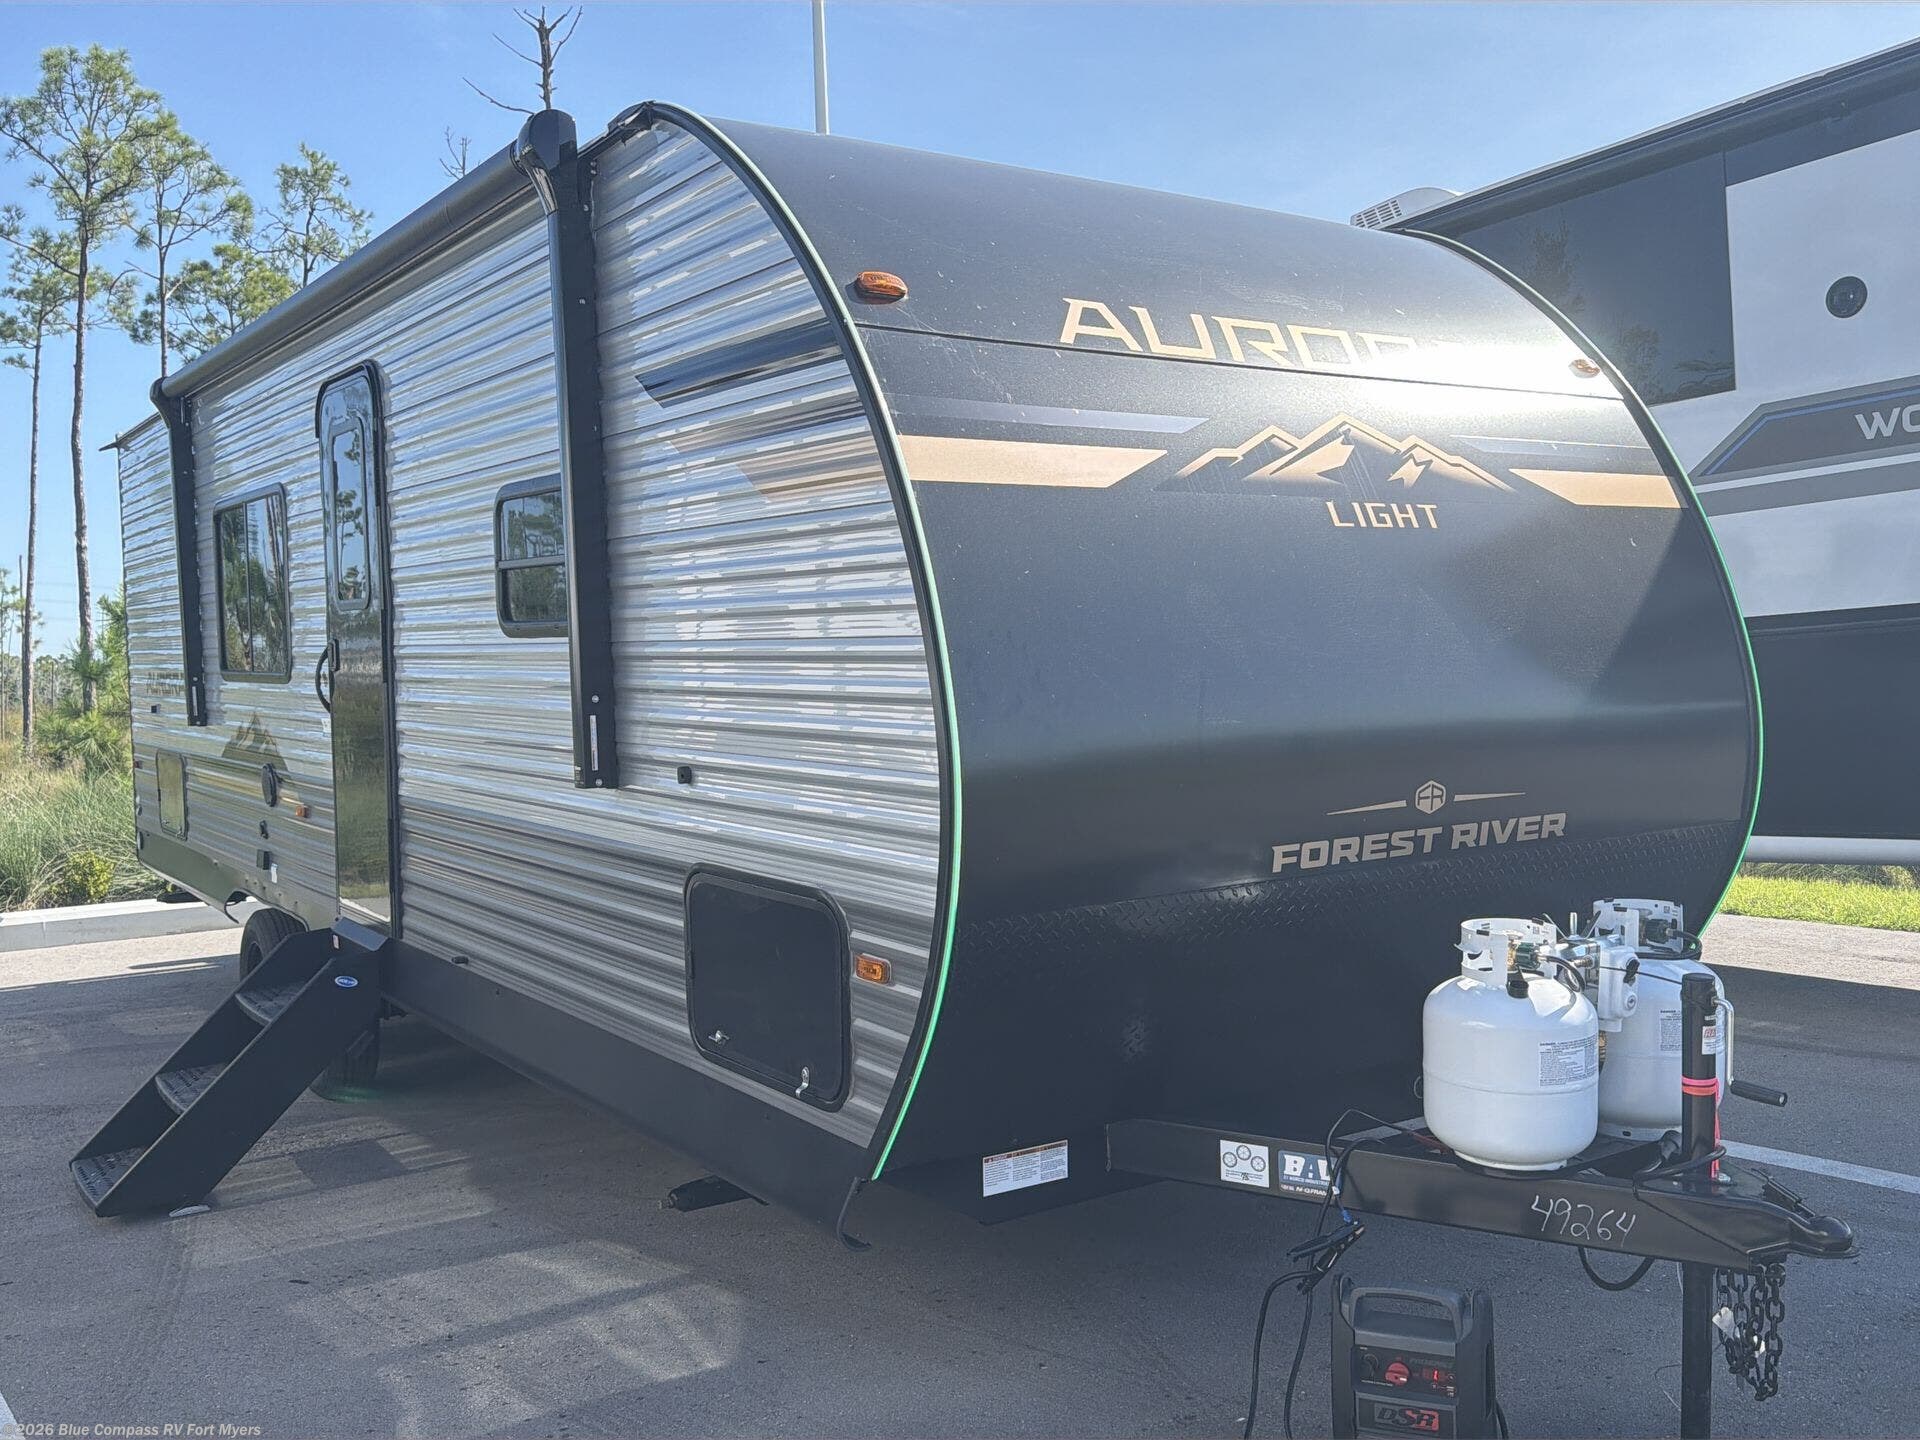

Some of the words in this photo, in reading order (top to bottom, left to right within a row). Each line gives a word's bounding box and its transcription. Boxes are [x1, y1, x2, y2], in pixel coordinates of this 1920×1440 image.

[1326, 501, 1438, 529] LIGHT
[1272, 826, 1443, 873] FOREST
[1451, 812, 1567, 850] RIVER
[1531, 1195, 1636, 1248] 49264
